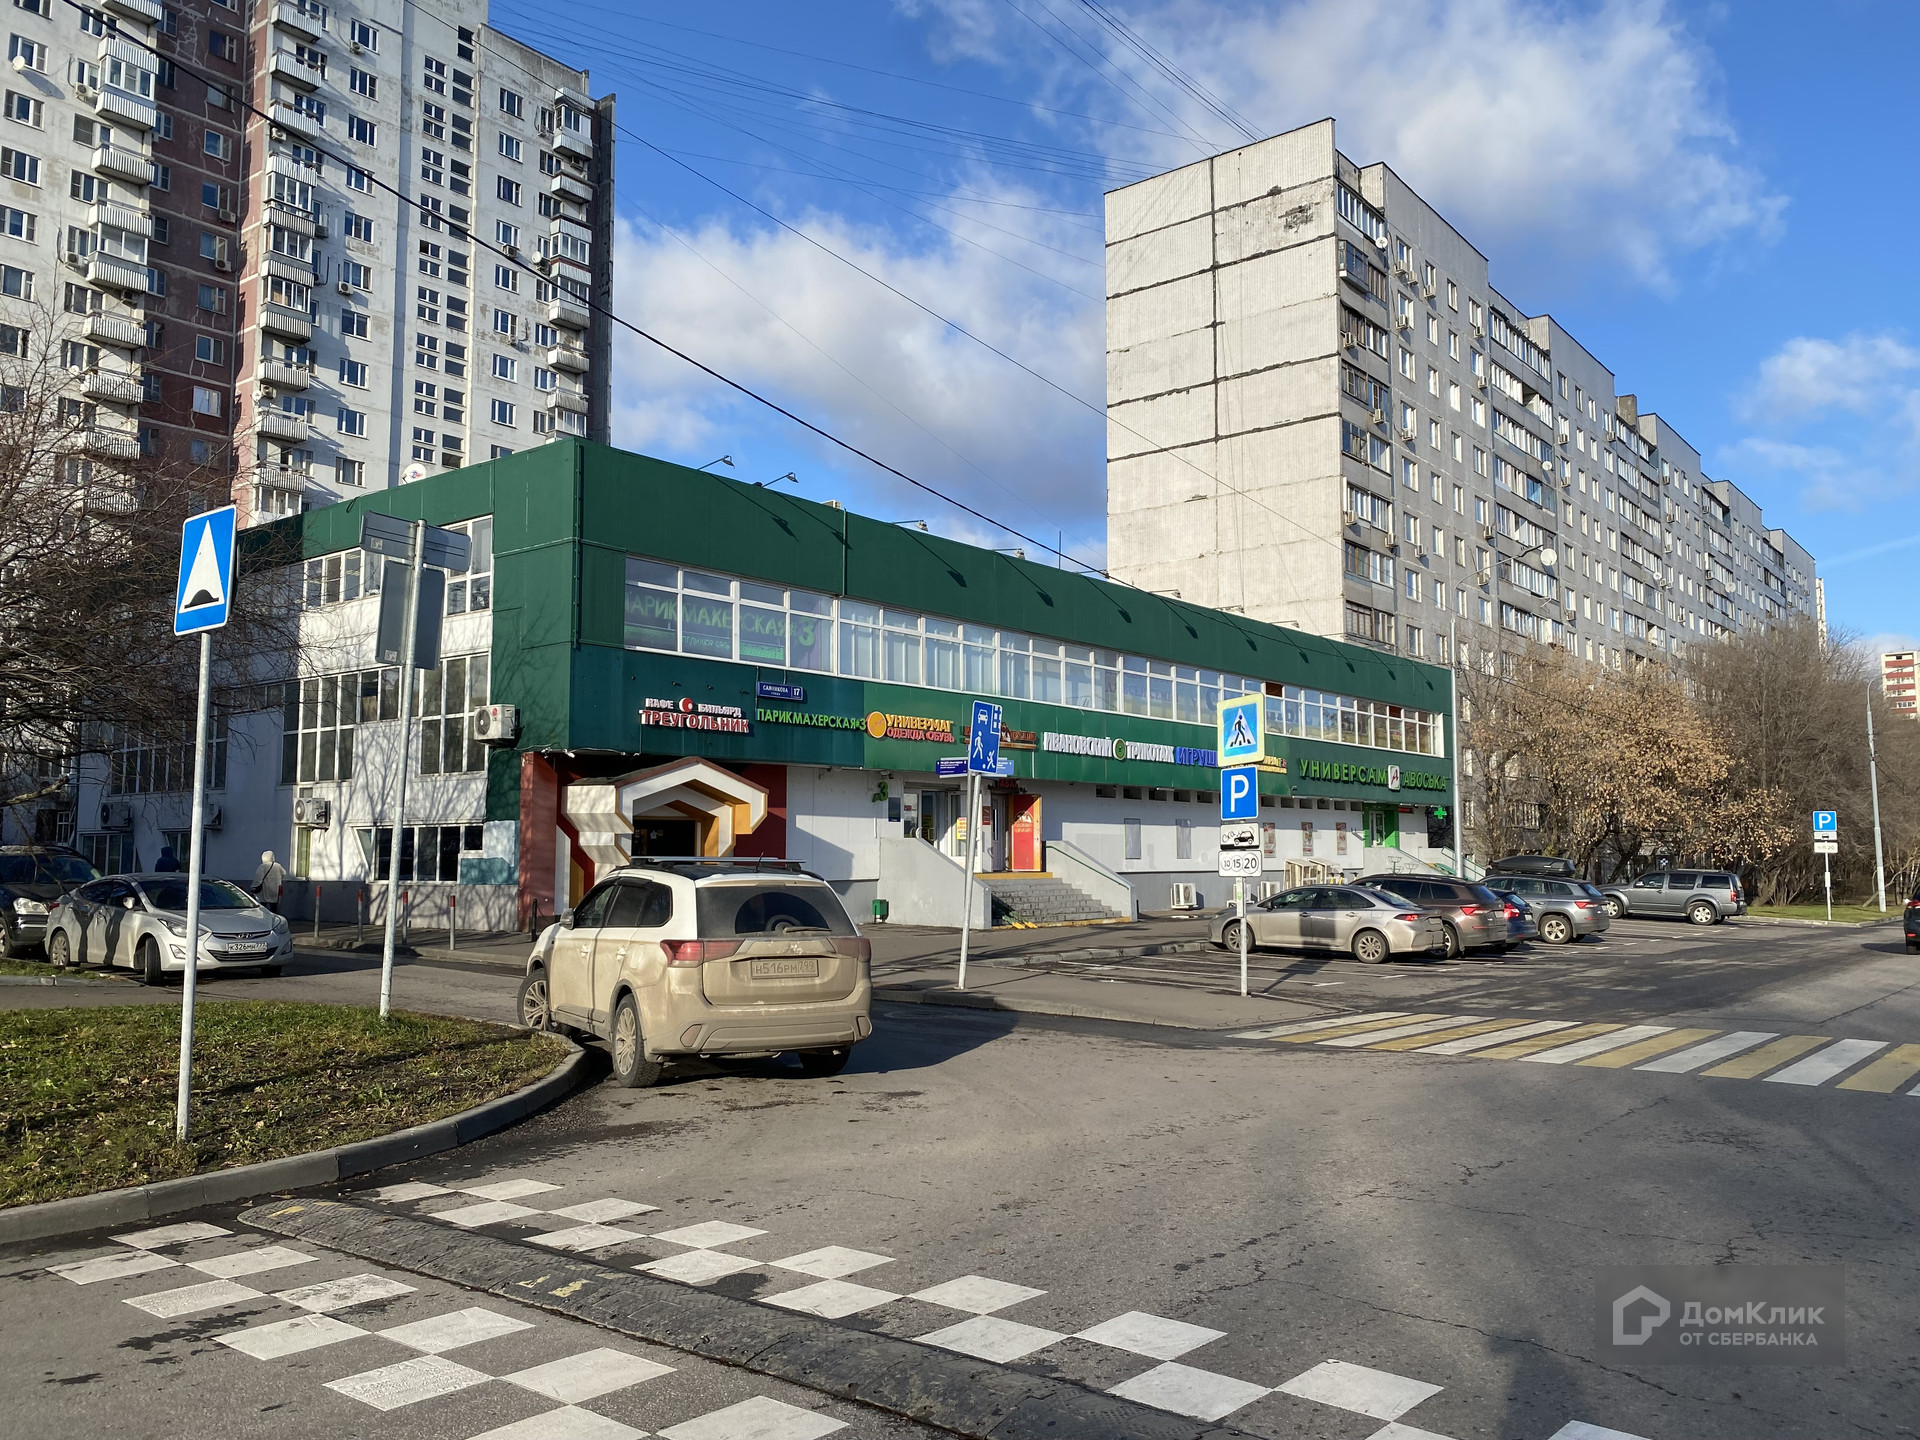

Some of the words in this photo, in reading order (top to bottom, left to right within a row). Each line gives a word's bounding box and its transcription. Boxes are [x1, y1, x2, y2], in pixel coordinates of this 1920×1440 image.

[793, 688, 800, 696] 17
[645, 698, 674, 709] КАФЕ
[698, 703, 742, 718] БИЛЬЯРД
[639, 709, 750, 733] ТРЕУГОЛЬНИК
[885, 713, 954, 732] УНИВЕРМАГ
[887, 727, 925, 740] ОДЕЖДА
[1043, 731, 1112, 758] ИВАНОВСКИЙ
[1126, 741, 1175, 763] ТРИКОТАЖ
[1175, 746, 1219, 768] ИГРУШ
[1300, 759, 1388, 785] УНИВЕРСАМ
[1403, 771, 1447, 790] АВОСЬКА
[1230, 774, 1249, 813] P
[1819, 813, 1831, 828] P
[1223, 859, 1231, 868] 10
[1233, 858, 1242, 869] 15
[1243, 857, 1258, 870] 20
